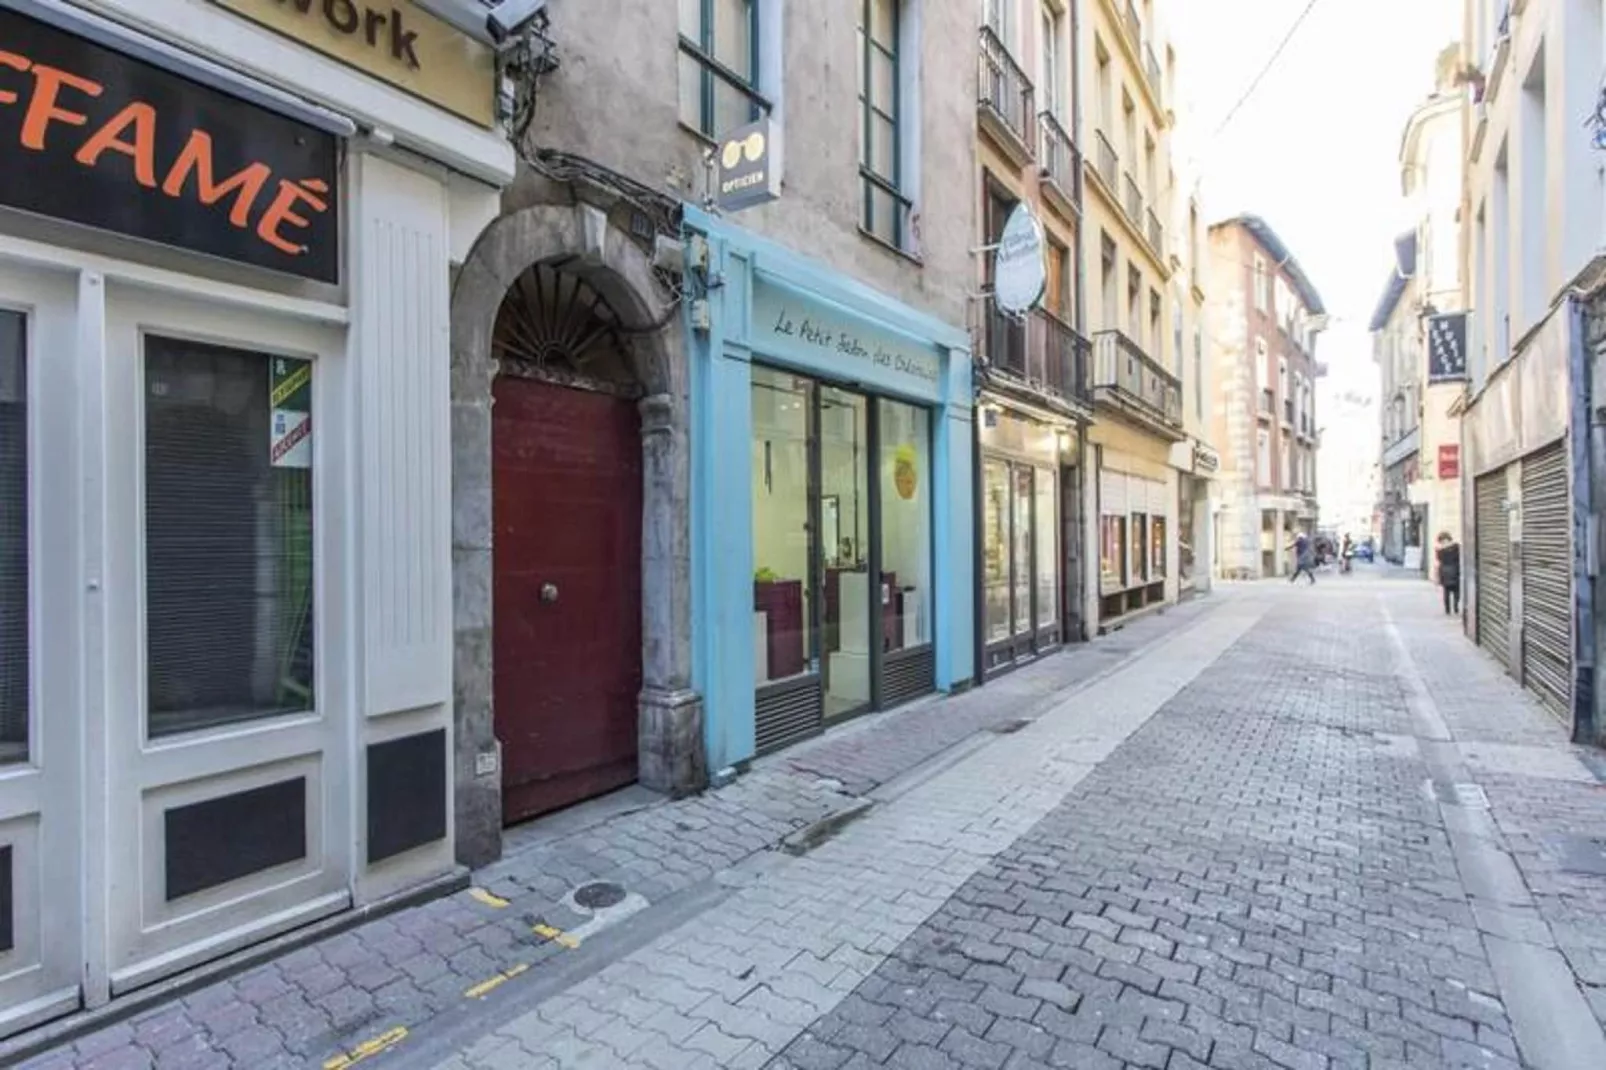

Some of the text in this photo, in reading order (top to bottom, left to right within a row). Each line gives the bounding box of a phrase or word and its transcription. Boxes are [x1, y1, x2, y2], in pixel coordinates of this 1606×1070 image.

[722, 171, 764, 193] OPTICIEN
[774, 307, 794, 336] Le
[800, 318, 832, 348] Petit
